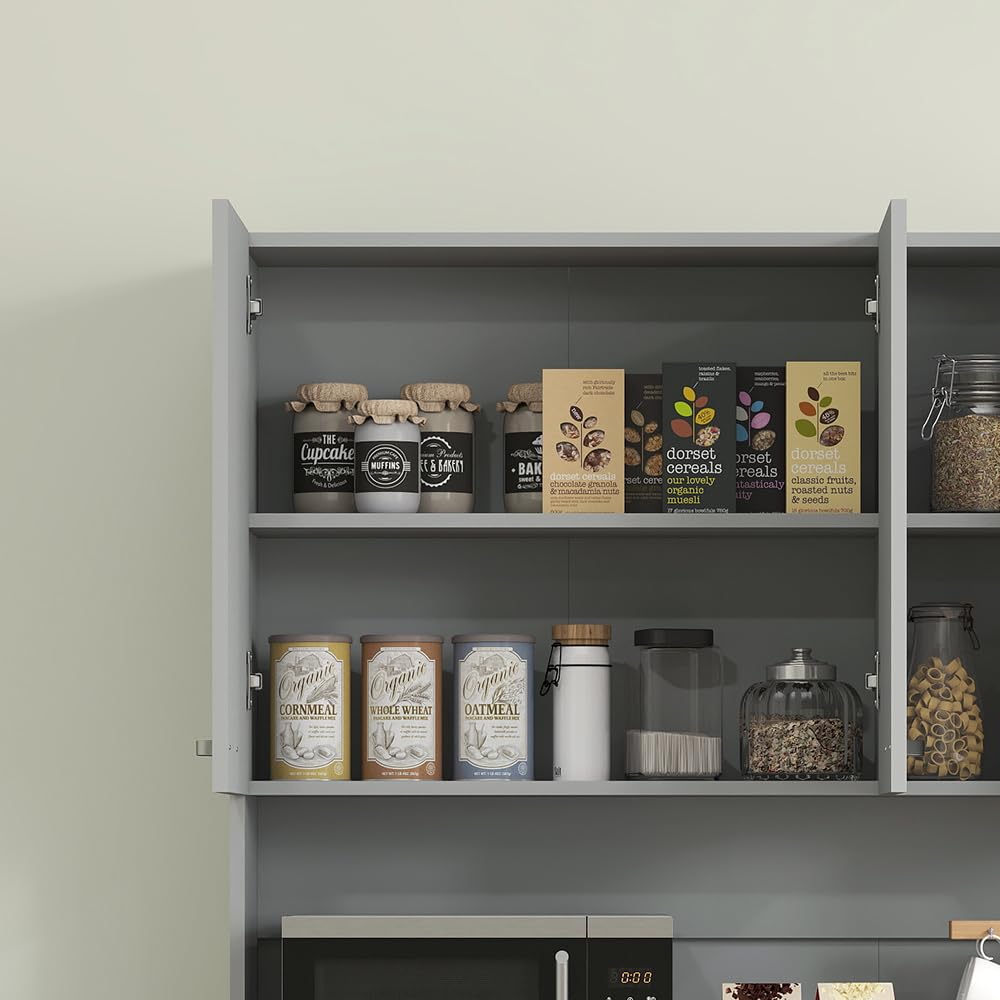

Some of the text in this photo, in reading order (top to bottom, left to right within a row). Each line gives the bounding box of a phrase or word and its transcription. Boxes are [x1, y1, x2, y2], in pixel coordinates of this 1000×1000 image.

[322, 434, 336, 444] THE
[301, 443, 354, 465] Cupcake
[666, 447, 717, 460] dorset
[791, 448, 840, 460] dorset
[371, 461, 400, 470] MUFFINS
[430, 460, 437, 473] &
[438, 459, 464, 473] BAKERY
[666, 461, 723, 474] cereals
[791, 461, 846, 474] cereals
[550, 472, 616, 480] dorset cereals
[667, 476, 716, 486] our lovely
[791, 476, 857, 485] classic fruits,
[550, 480, 618, 489] chocolate granola
[791, 486, 828, 494] roasted
[667, 486, 704, 496] organic
[667, 496, 701, 505] muesli
[792, 496, 829, 504] & seeds
[279, 661, 334, 700] Organic
[370, 661, 426, 700] Organic
[462, 661, 518, 700] Organic
[279, 704, 338, 716] CORNMEAL
[370, 706, 433, 715] WHOLE WHEAT
[464, 704, 520, 716] OATMEAL
[621, 972, 652, 984] 0:00
